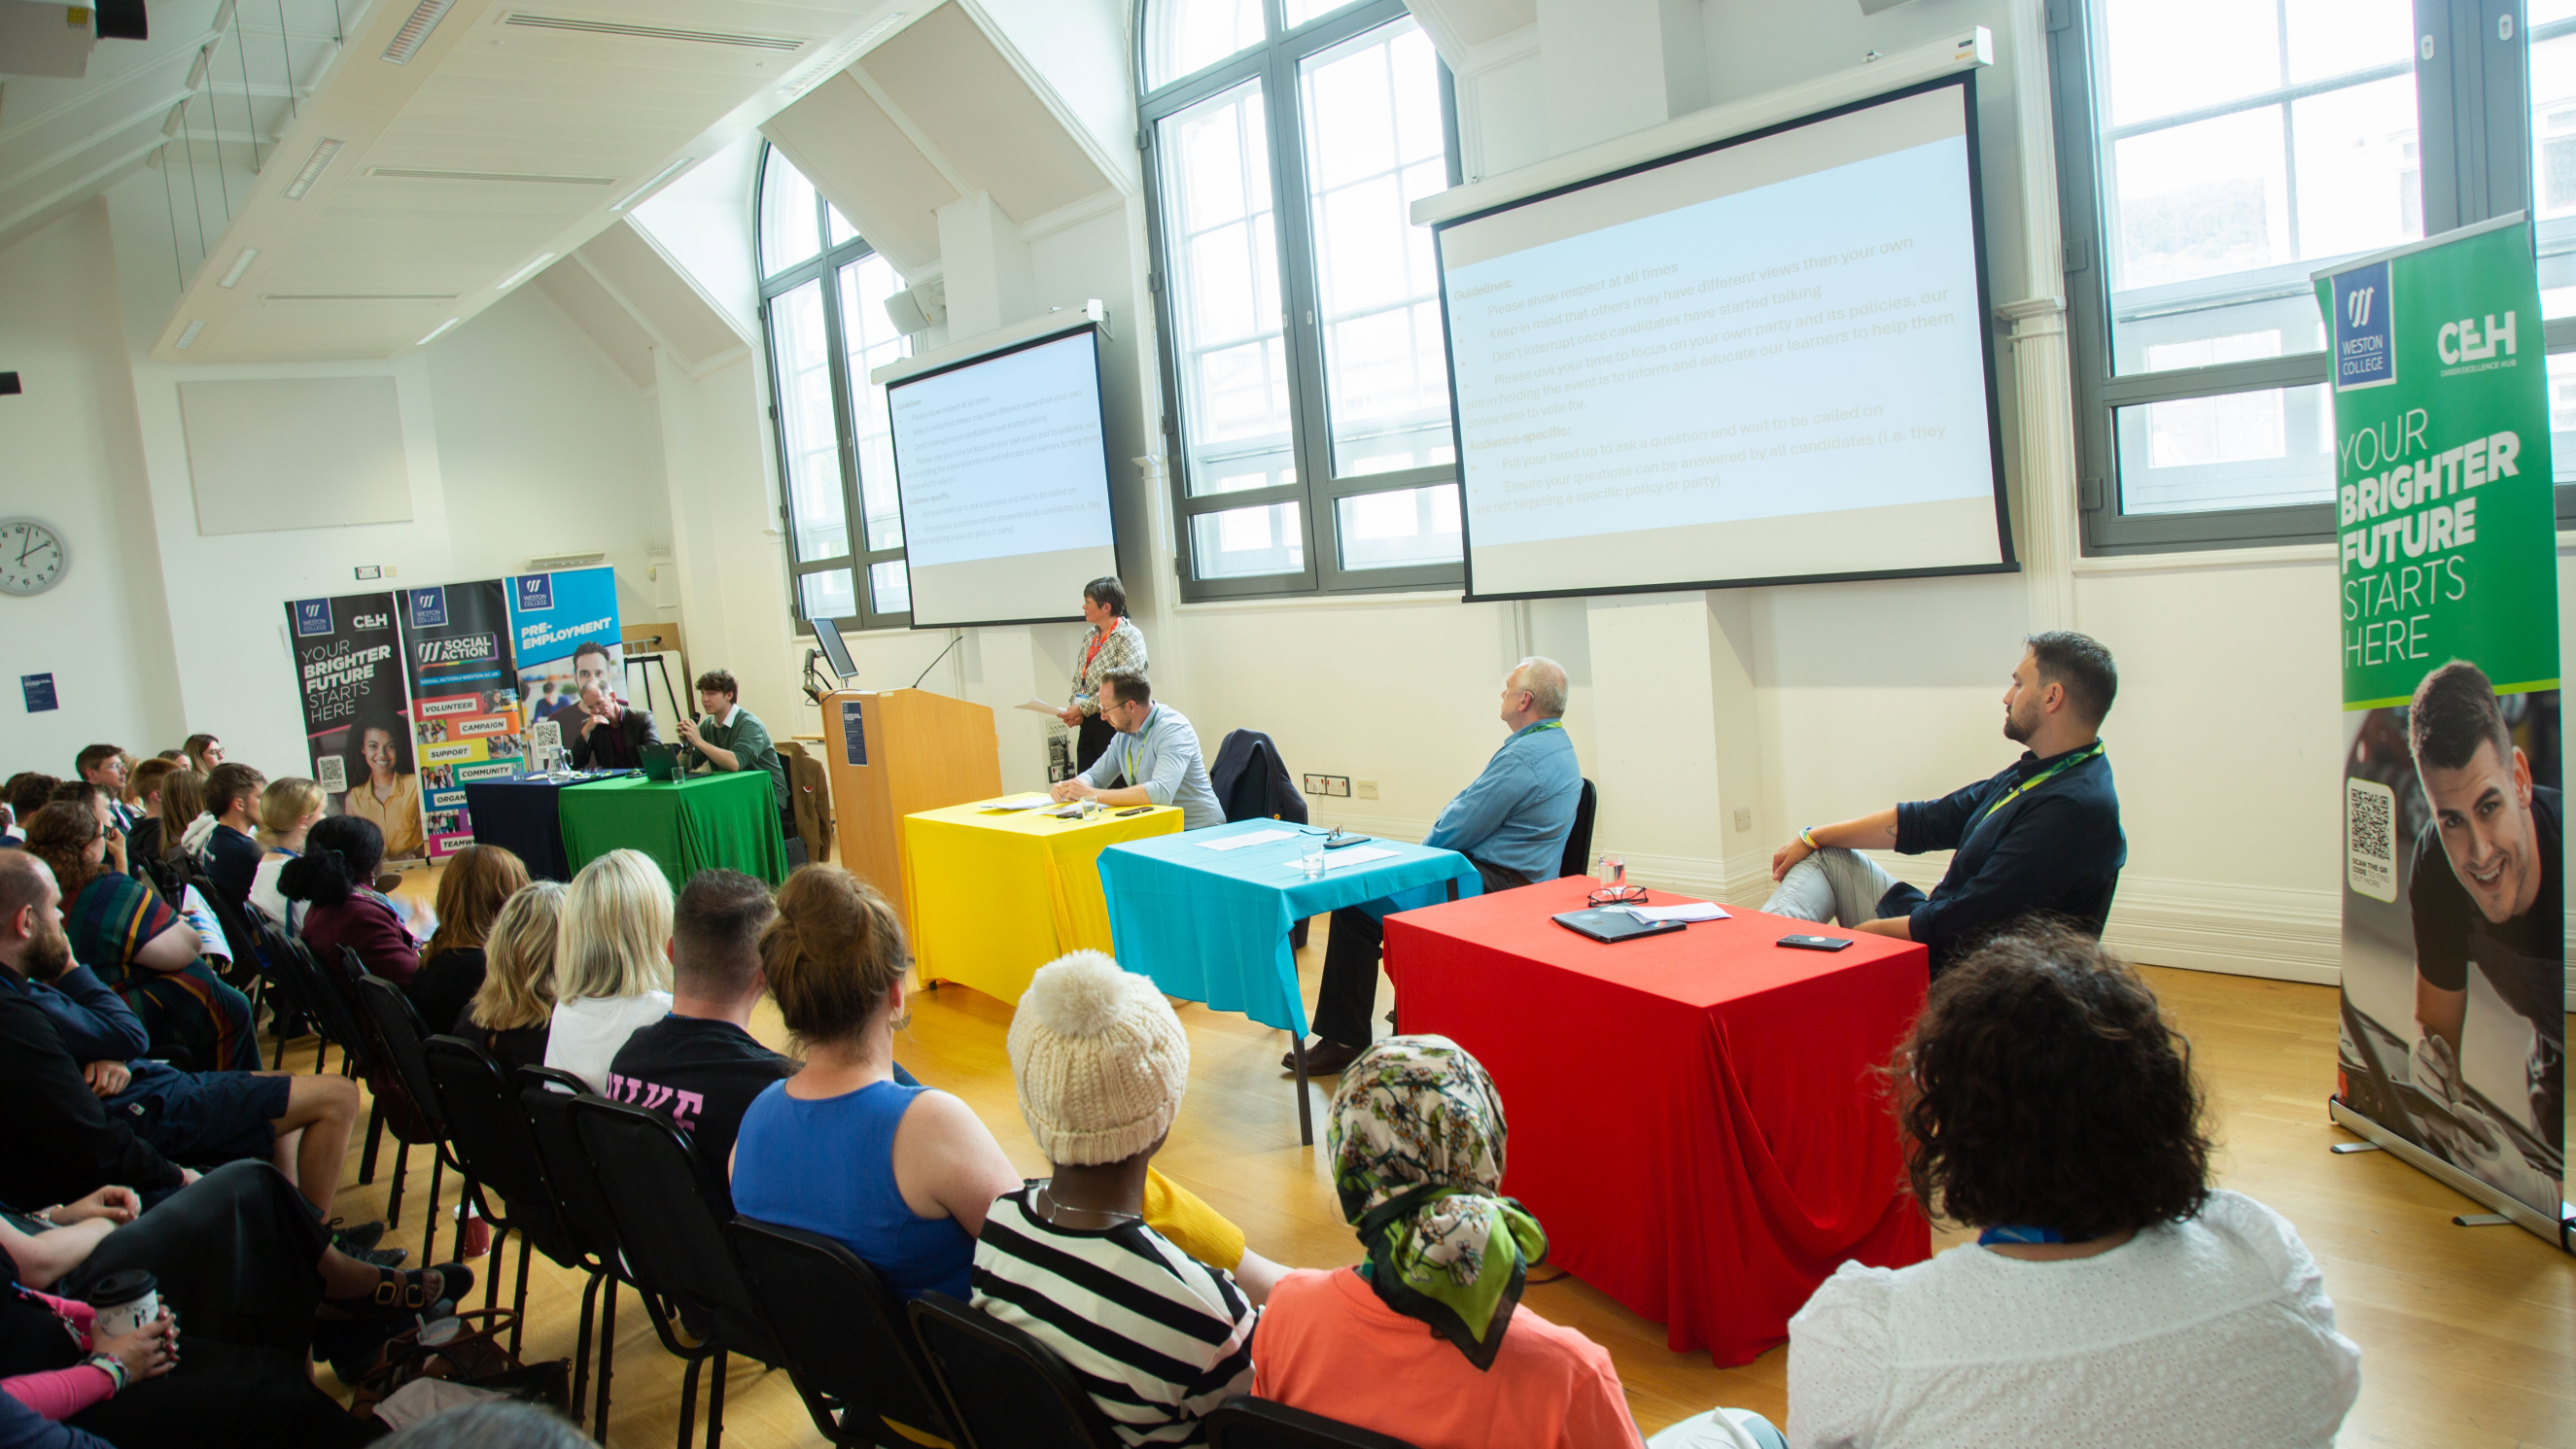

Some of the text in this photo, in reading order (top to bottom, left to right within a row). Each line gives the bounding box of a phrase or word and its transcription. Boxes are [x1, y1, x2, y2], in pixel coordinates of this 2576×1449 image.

[1453, 276, 1513, 301] Guidelines:
[1487, 260, 1678, 317] Please show respect at all times
[1489, 236, 1913, 342] Keep in mind that others may have different views than your own
[1491, 282, 1822, 362] Don't interrupt once candidates have started talking
[1493, 289, 1949, 386] Please use your time to focus on your own party and its policies, our
[2343, 334, 2384, 356] WESTON
[2438, 311, 2517, 365] CEH
[1463, 309, 1954, 410] aim in holding the event is to inform and educate our learners to help them
[2343, 357, 2384, 376] COLLEGE
[2441, 359, 2517, 377] CAREER EXCELLENCE HUB
[1466, 397, 1586, 430] chose who to vote for.
[1467, 424, 1572, 454] Audience-specific:
[1502, 404, 1883, 468] Put your hand up to ask a question and wait to be called on
[2339, 408, 2428, 477] YOUR
[1504, 422, 1946, 493] Ensure your questions can be answered by all candidates (i.e. they
[1474, 472, 1721, 514] are not targeting a specific policy or party)
[2341, 431, 2521, 527] BRIGHTER
[2342, 496, 2477, 575] FUTURE
[2344, 555, 2465, 622] STARTS
[353, 613, 388, 629] CEH
[521, 622, 552, 638] PRE-
[522, 616, 612, 650] EMPLOYMENT
[301, 639, 350, 664] YOUR
[440, 645, 489, 661] ACTION
[444, 636, 492, 650] SOCIAL
[2346, 614, 2430, 669] HERE
[303, 645, 391, 679] BRIGHTER
[306, 663, 374, 694] FUTURE
[309, 680, 369, 708] STARTS
[425, 702, 473, 712] VOLUNTEER
[311, 700, 355, 724] HERE
[462, 721, 505, 732] CAMPAIGN
[431, 748, 469, 758] SUPPORT
[462, 766, 510, 777] COMMUNITY
[2352, 857, 2367, 867] SCAN
[2368, 862, 2378, 872] THE
[2352, 866, 2390, 882] CODE TO FIND
[2353, 874, 2381, 888] OUT MORE
